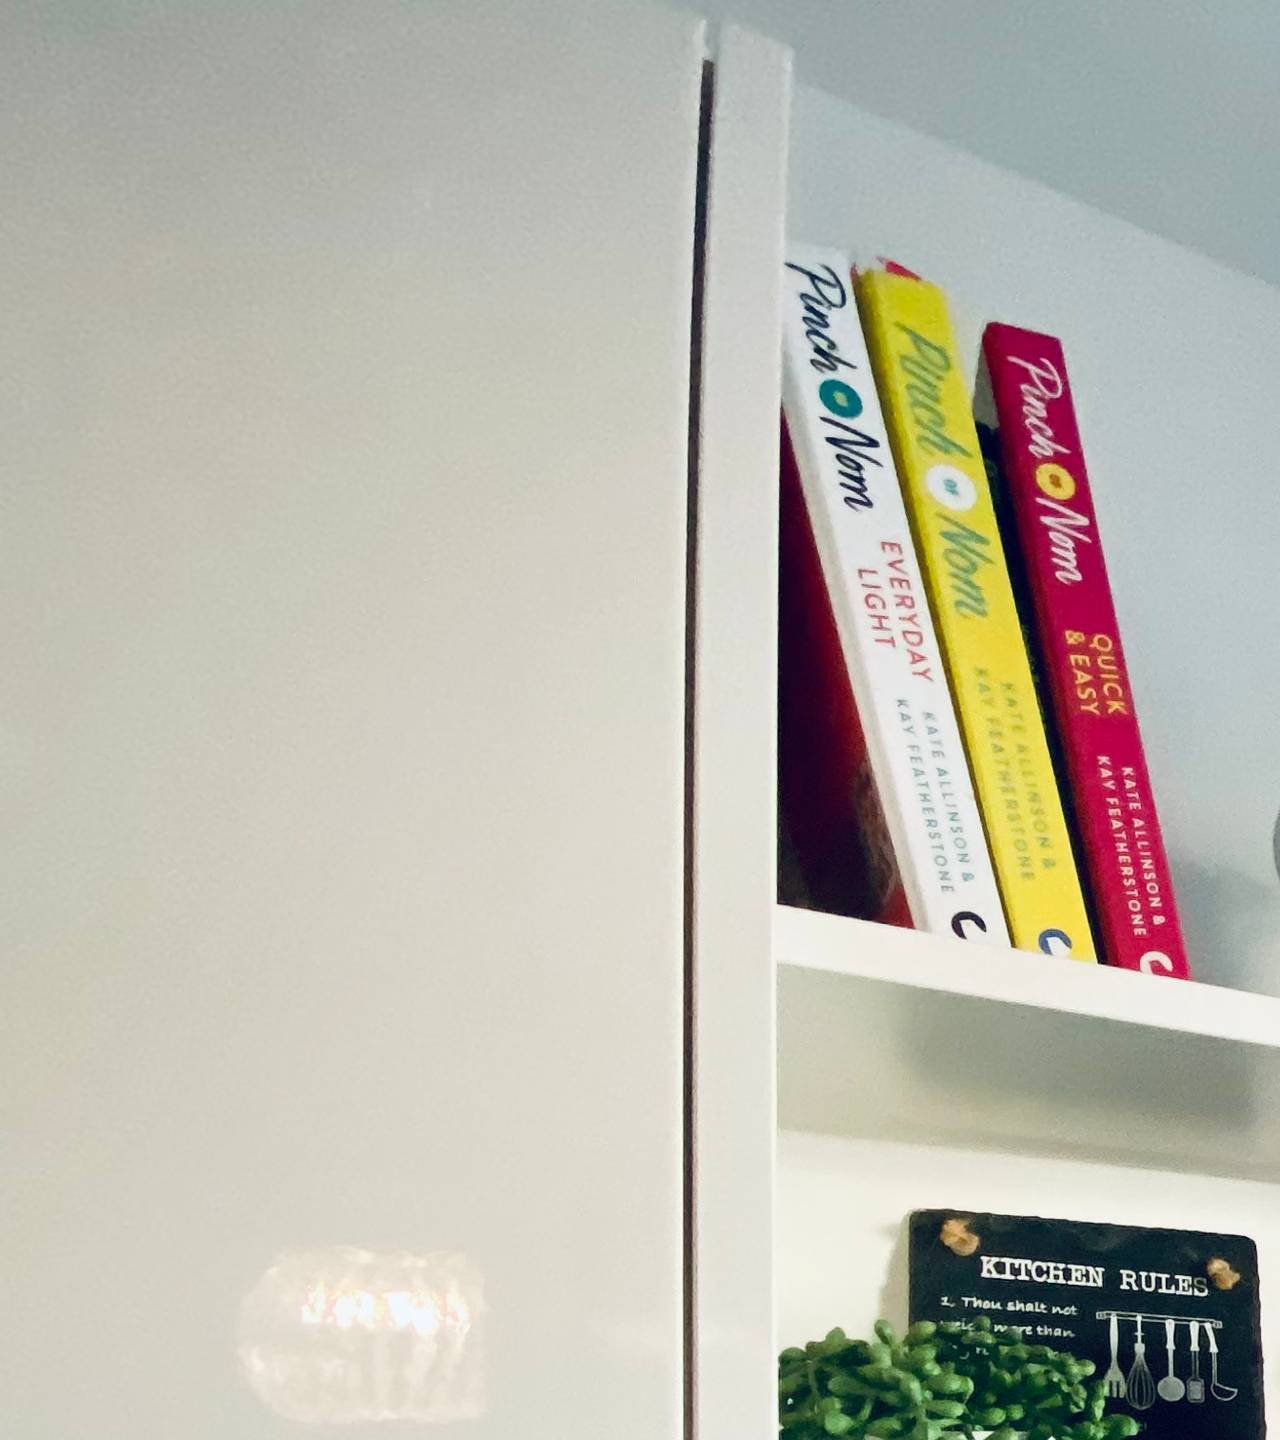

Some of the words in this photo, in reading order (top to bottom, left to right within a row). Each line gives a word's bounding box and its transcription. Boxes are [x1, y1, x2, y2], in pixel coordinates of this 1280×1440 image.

[784, 261, 857, 375] Pinch
[1006, 356, 1072, 460] Pinch
[819, 415, 884, 513] Nom
[895, 321, 974, 460] Pinch
[936, 512, 996, 620] Nom
[1035, 497, 1092, 585] Nom
[857, 567, 897, 648] LIGHT
[880, 541, 934, 682] EVERYDAY
[1065, 629, 1085, 645] &
[1069, 654, 1101, 716] EASY
[1093, 633, 1127, 714] QUICK
[896, 699, 917, 738] KAY
[907, 744, 955, 892] FEATHERSTONE
[922, 711, 946, 759] KATE
[936, 767, 970, 863] ALLINSON
[961, 871, 975, 882] &
[1097, 755, 1117, 791] KAY
[1121, 766, 1142, 812] KATE
[1105, 797, 1147, 937] FEATHERSTONE
[1131, 817, 1162, 909] ALLINSON
[1152, 914, 1166, 926] &
[961, 1296, 1003, 1310] Thou
[1006, 1300, 1048, 1313] shalt
[1051, 1305, 1080, 1316] not
[980, 1255, 1106, 1288] KITCHEN
[1119, 1269, 1209, 1297] RULES
[1036, 1324, 1076, 1338] than
